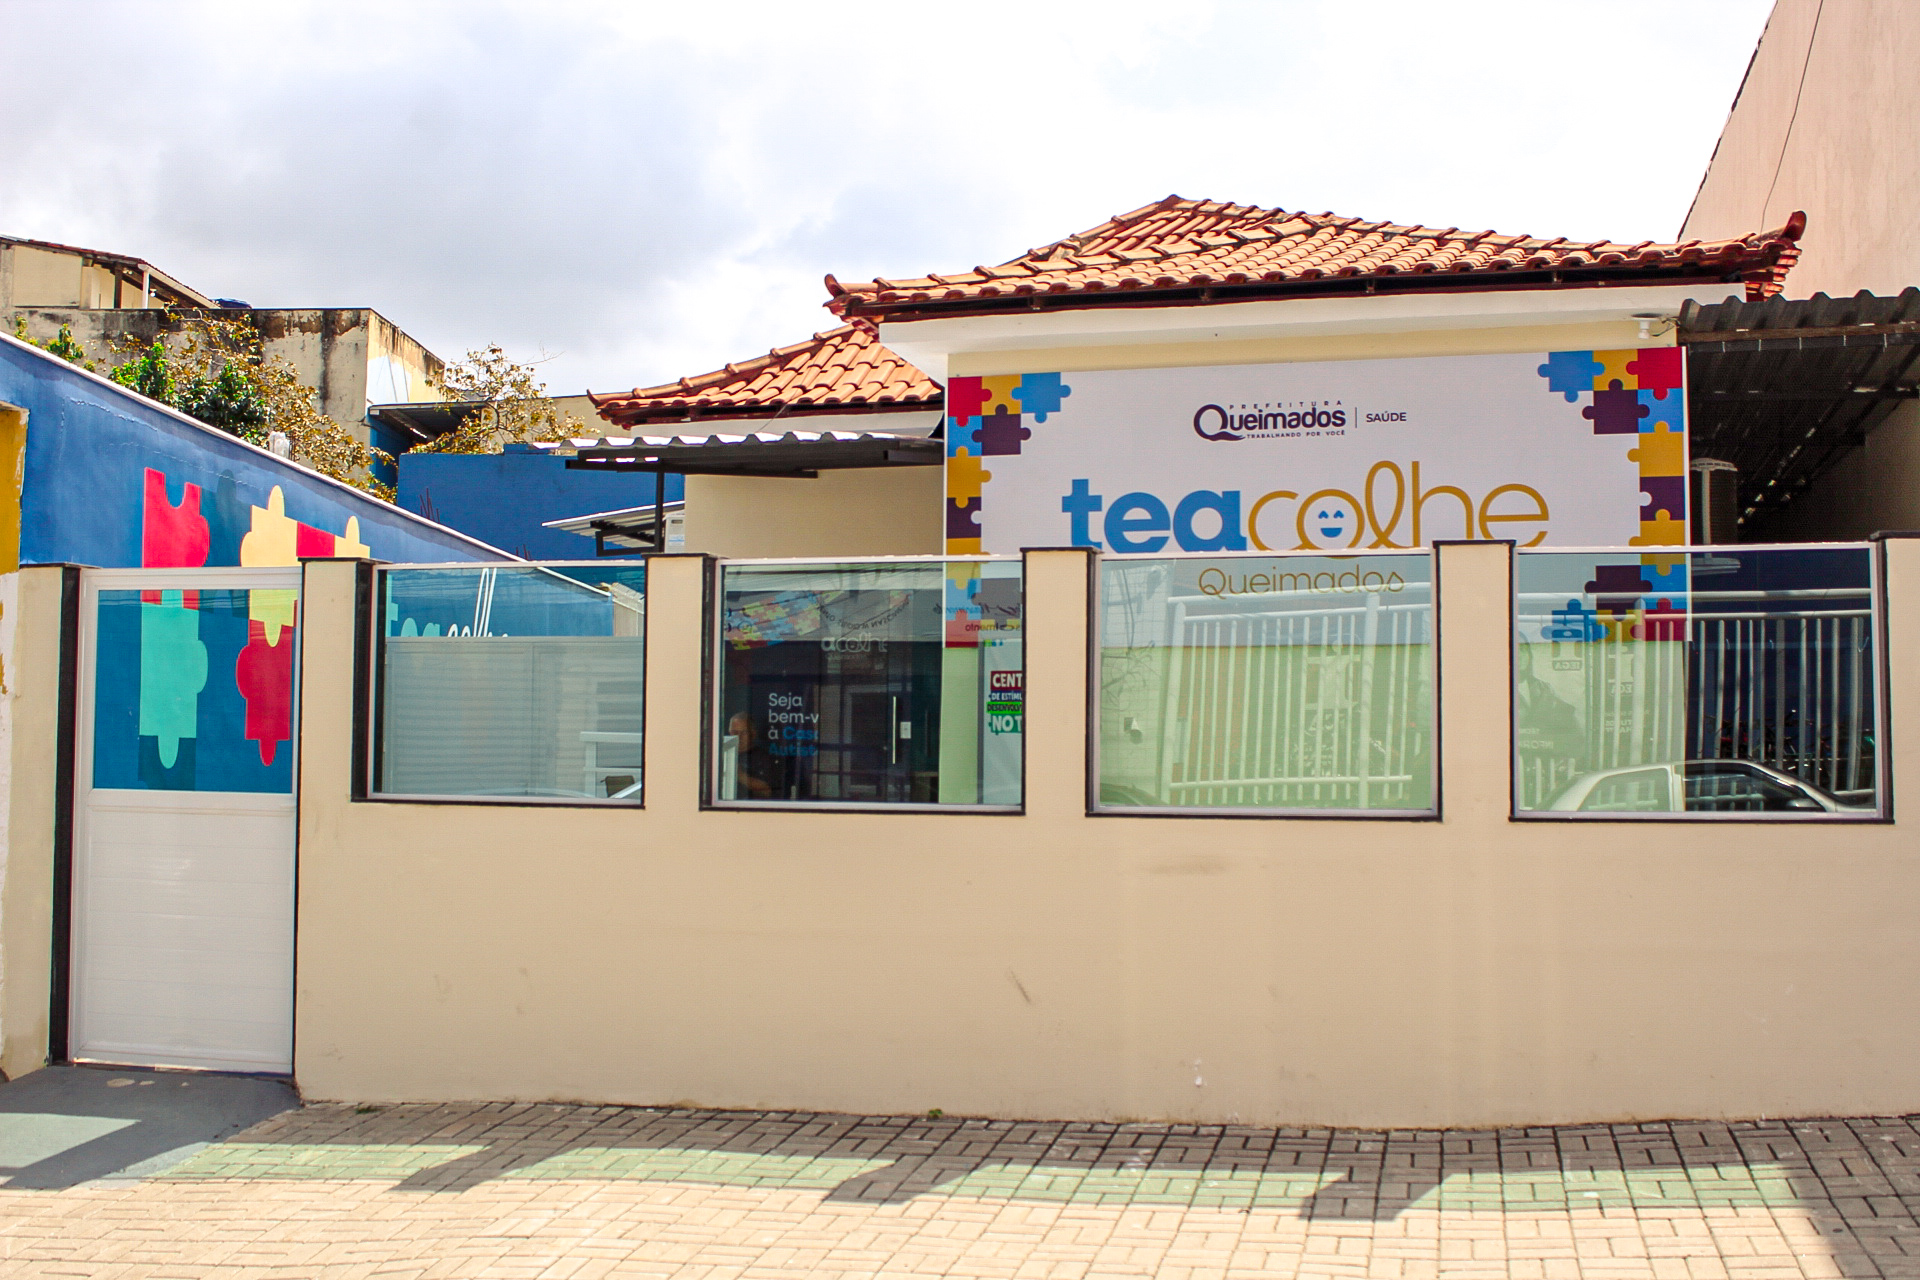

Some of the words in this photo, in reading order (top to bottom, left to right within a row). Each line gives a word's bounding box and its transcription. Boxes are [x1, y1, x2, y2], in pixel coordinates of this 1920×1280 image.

[1229, 400, 1342, 410] PREFEITURA
[1193, 403, 1347, 441] Queimados
[1366, 410, 1407, 423] SAÚDE
[1198, 564, 1405, 600] Queimados
[992, 672, 1022, 688] CENT
[768, 692, 803, 710] Seja
[991, 692, 1001, 701] DE
[768, 709, 819, 724] bem-v
[767, 725, 779, 740] à
